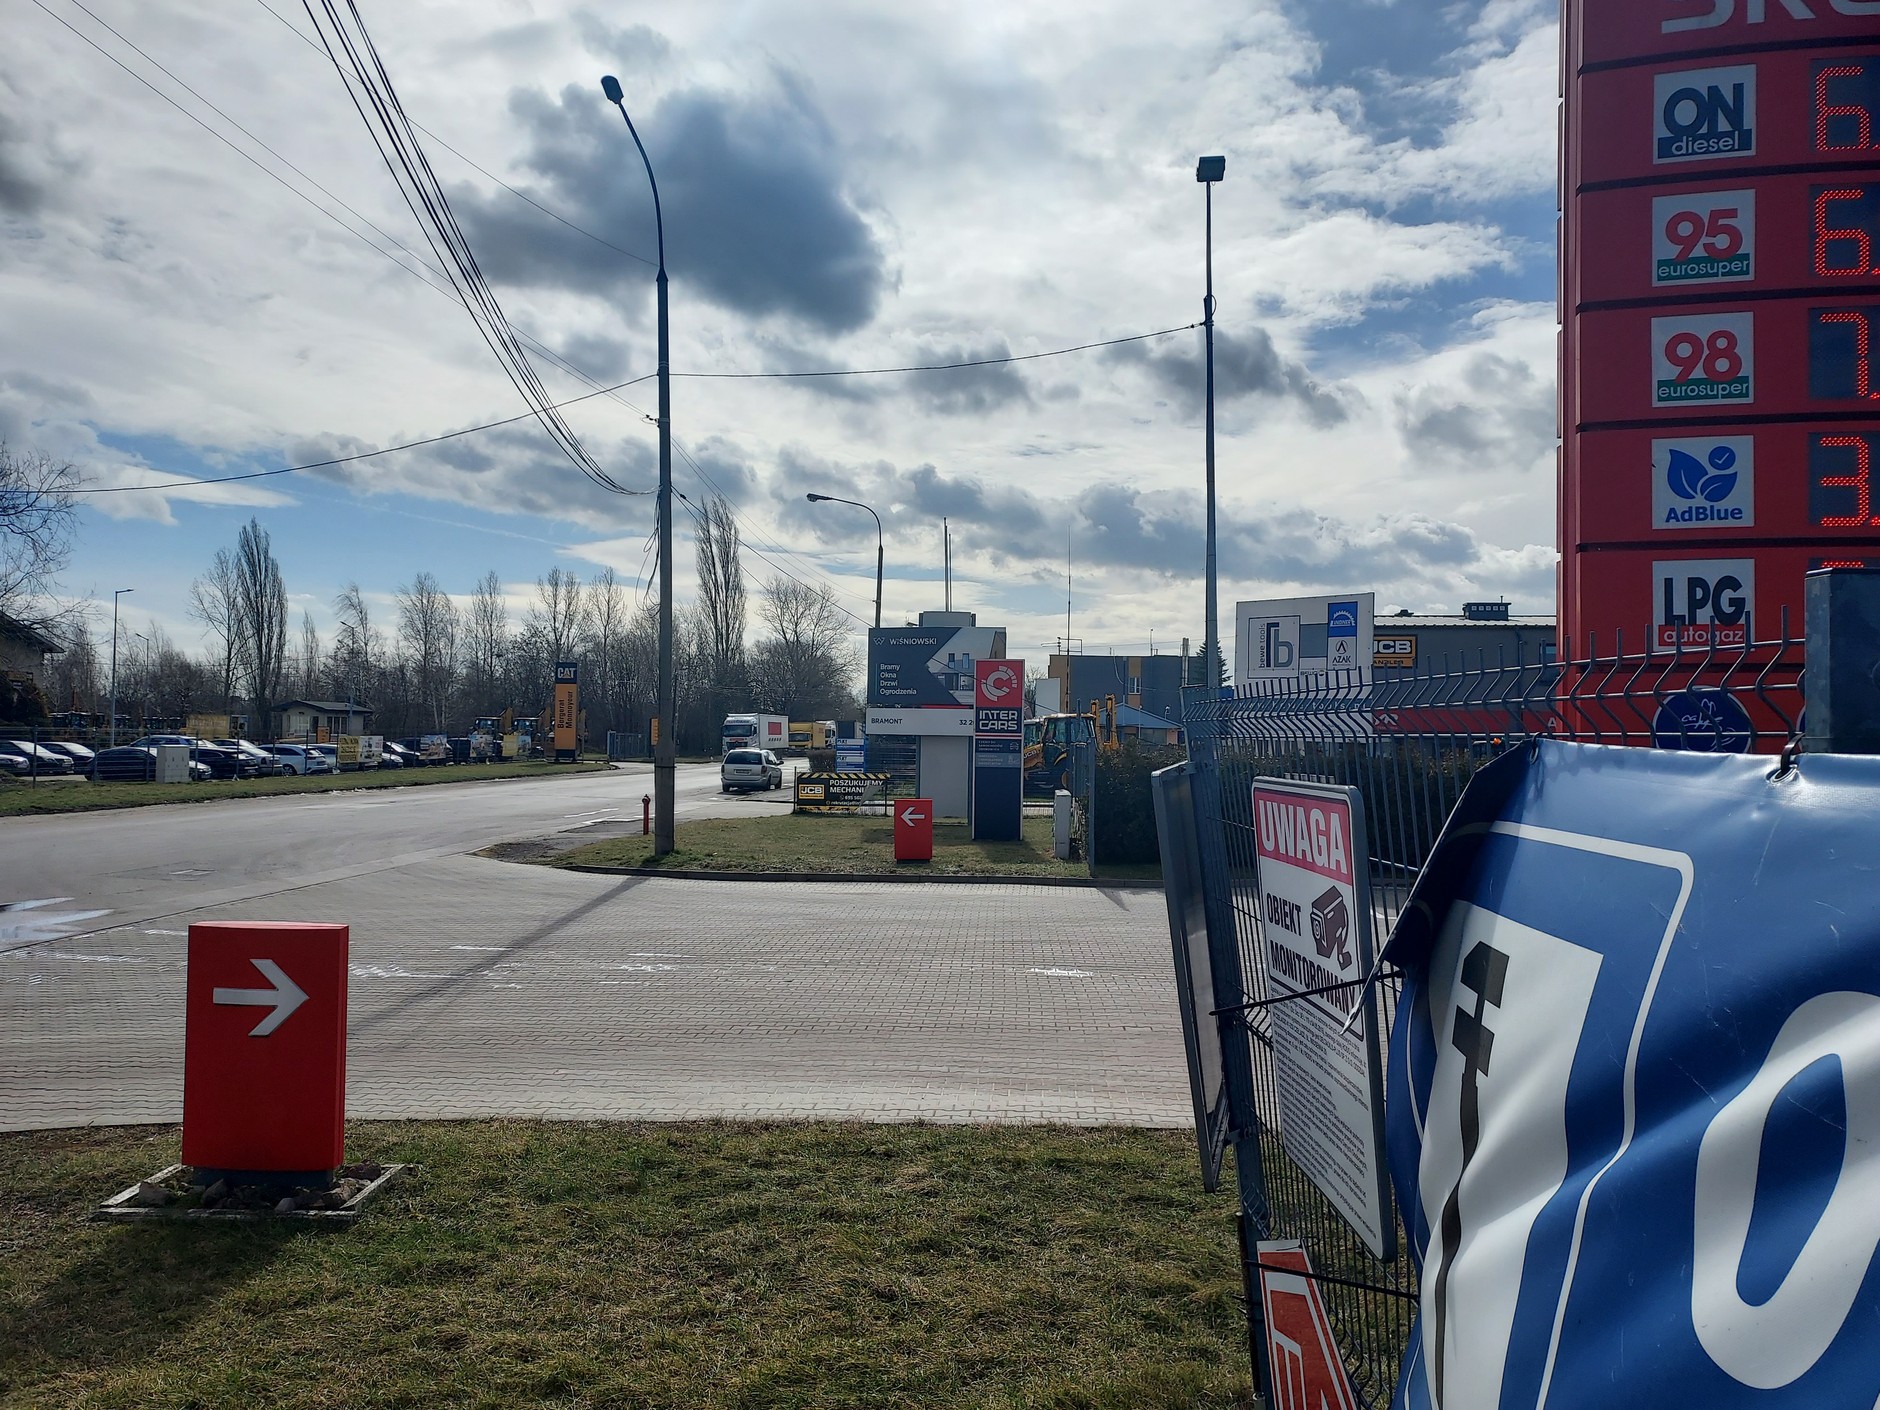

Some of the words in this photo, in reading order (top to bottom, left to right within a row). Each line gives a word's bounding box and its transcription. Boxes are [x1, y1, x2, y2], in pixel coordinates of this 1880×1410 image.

[1663, 82, 1744, 136] ON
[1672, 131, 1739, 156] diesel
[1664, 208, 1743, 262] 95
[1658, 259, 1749, 278] eurosuper
[1664, 329, 1742, 383] 98
[1658, 381, 1748, 400] eurosuper
[1665, 504, 1743, 523] AdBlue
[1664, 575, 1746, 627] LPG
[1258, 623, 1266, 643] tools
[1258, 645, 1266, 669] bewe
[1332, 655, 1351, 664] AZAK
[557, 667, 576, 679] CAT
[880, 663, 900, 671] Bramy
[880, 679, 898, 687] Drzwi
[880, 688, 917, 696] Ogrodzenia
[979, 710, 1018, 720] INTER
[979, 720, 1018, 730] CARS
[801, 786, 823, 794] JCB
[1258, 799, 1349, 875] UWAGA
[1266, 892, 1302, 937] OBIEKT
[1269, 939, 1356, 1017] MONITOROWANY
